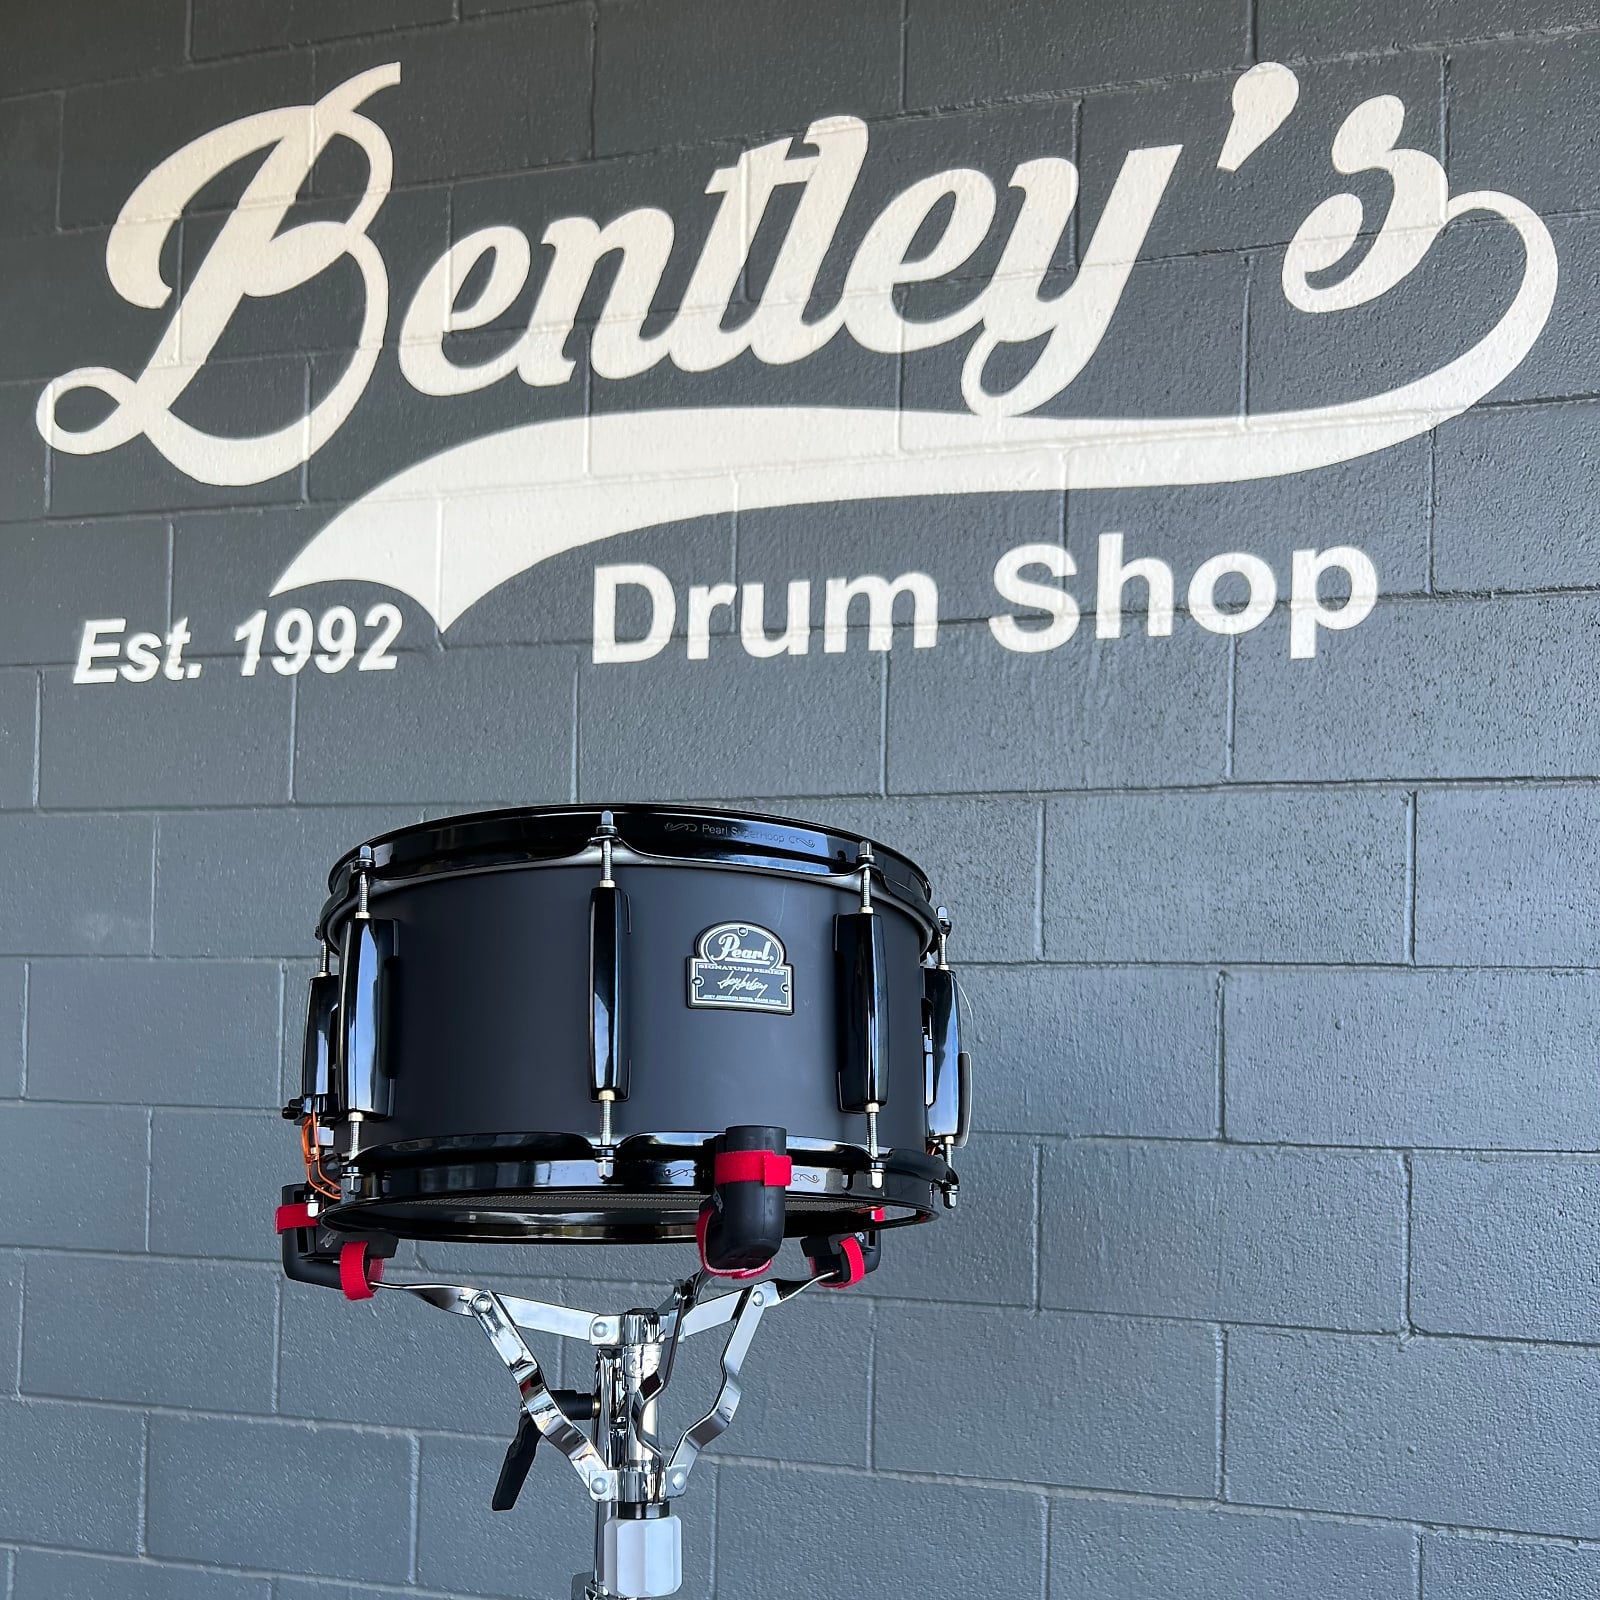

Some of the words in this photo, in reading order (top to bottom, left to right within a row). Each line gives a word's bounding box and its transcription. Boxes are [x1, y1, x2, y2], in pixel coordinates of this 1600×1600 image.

[36, 61, 1558, 487] Bentley's
[592, 563, 938, 664] Drum
[988, 532, 1379, 660] Shop
[73, 617, 202, 684] Est.
[234, 603, 402, 677] 1992
[702, 824, 728, 836] Pearl
[698, 964, 753, 973] SIGNATURE
